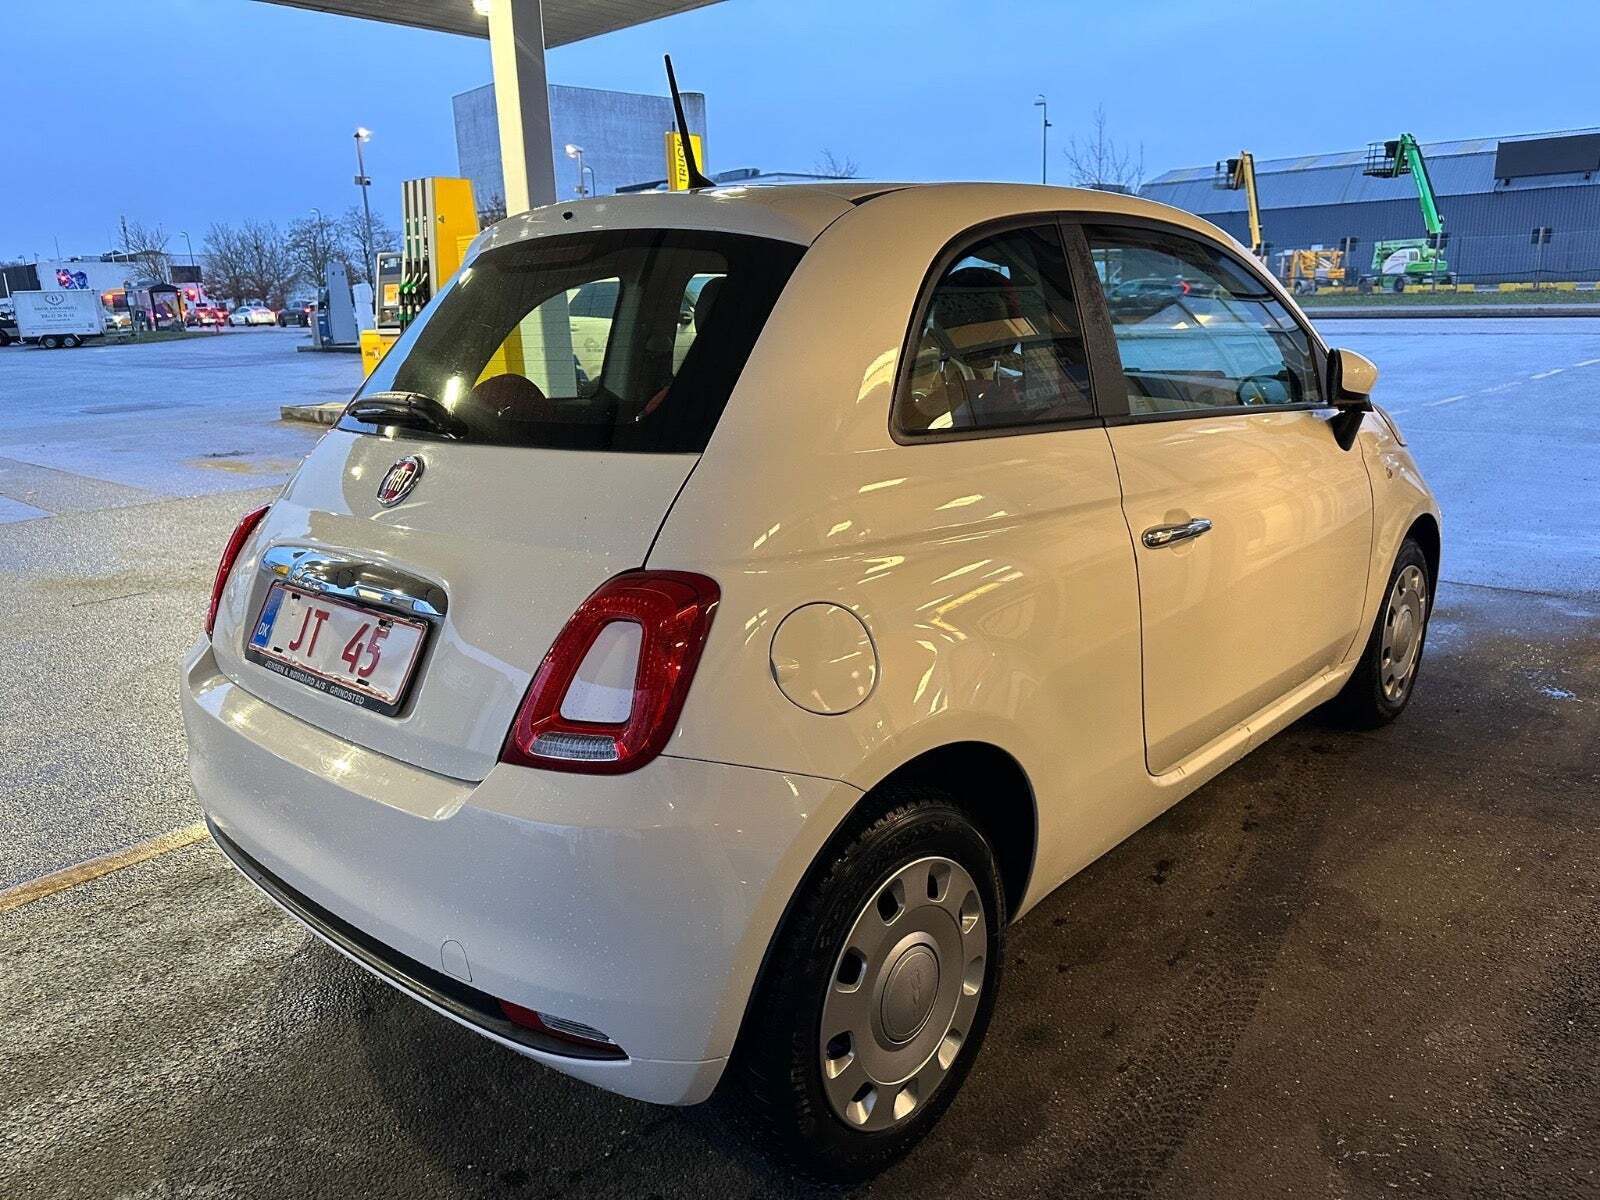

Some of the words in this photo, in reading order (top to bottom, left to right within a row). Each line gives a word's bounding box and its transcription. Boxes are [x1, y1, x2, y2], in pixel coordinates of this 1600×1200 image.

[385, 469, 412, 492] FIAT
[257, 623, 270, 637] DK
[288, 606, 331, 657] JT
[341, 623, 391, 678] 45
[329, 685, 365, 705] GRINDSTED
